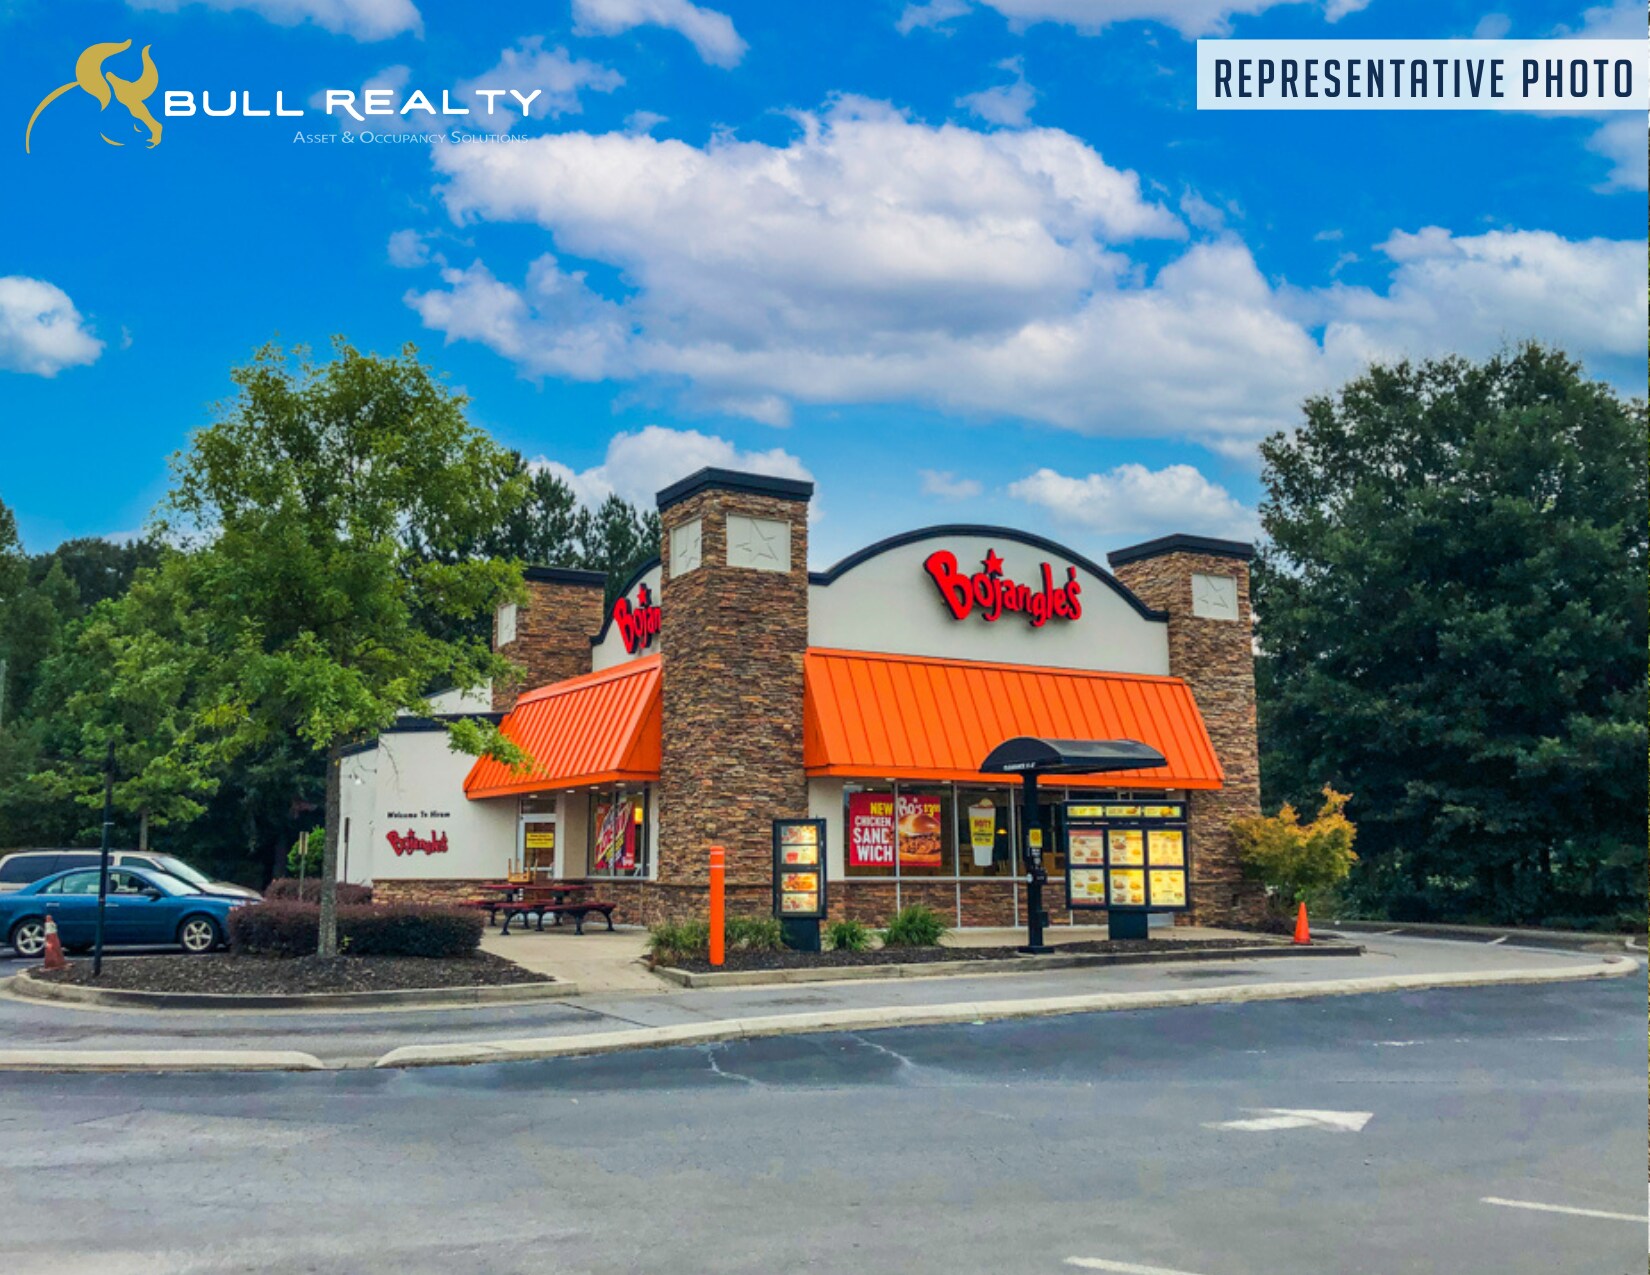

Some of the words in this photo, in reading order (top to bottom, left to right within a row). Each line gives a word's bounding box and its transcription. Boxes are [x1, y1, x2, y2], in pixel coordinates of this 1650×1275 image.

[870, 802, 893, 815] NEW
[854, 815, 892, 827] CHICKEN
[857, 845, 893, 862] WICH
